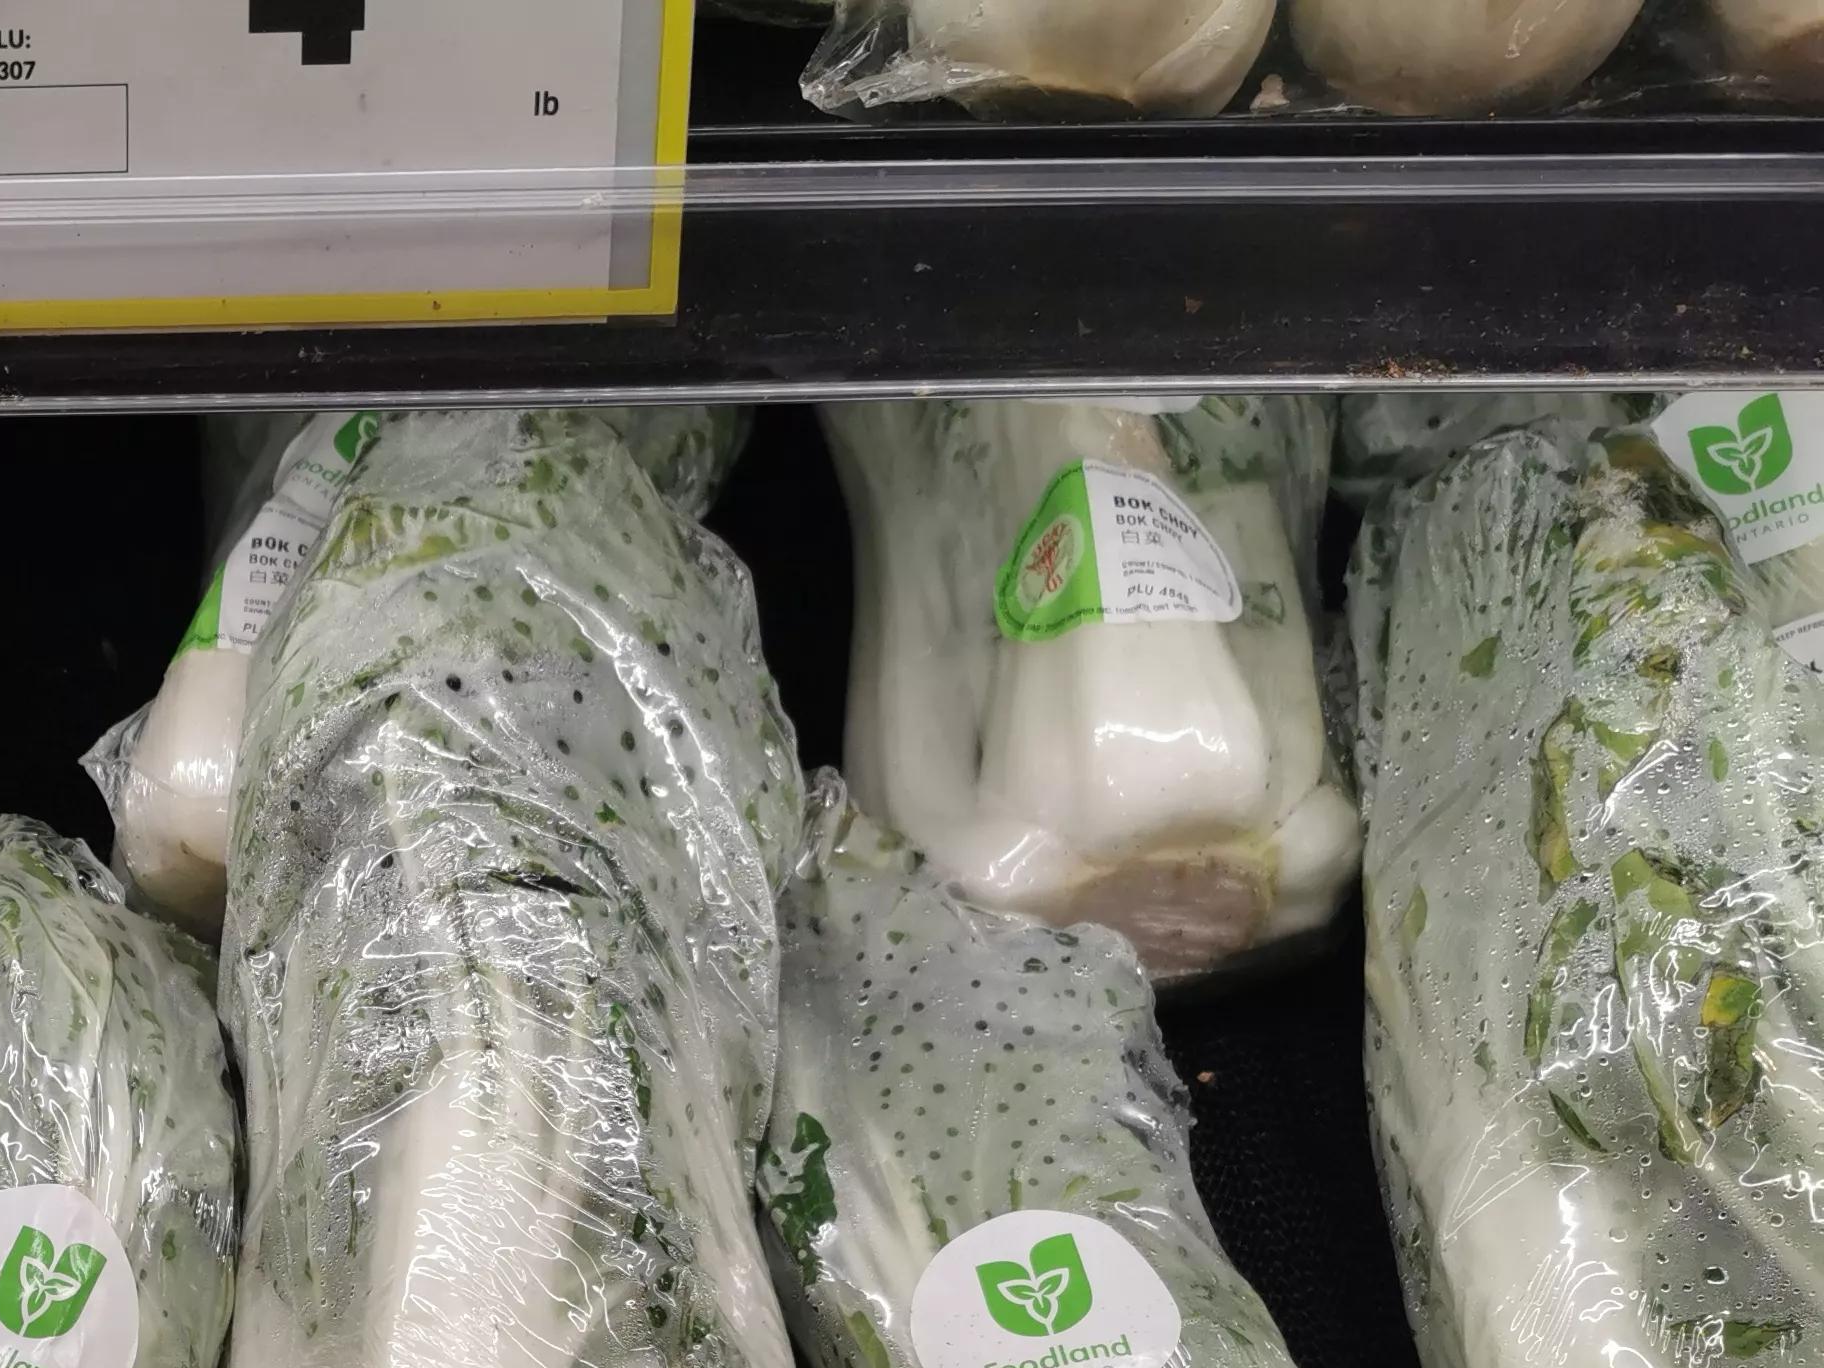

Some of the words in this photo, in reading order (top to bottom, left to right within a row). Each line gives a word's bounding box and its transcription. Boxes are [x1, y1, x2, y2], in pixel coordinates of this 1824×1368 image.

[534, 91, 560, 117] lb
[1113, 496, 1154, 512] BOK
[1158, 507, 1198, 540] CHOY
[1116, 514, 1147, 527] BOK
[1736, 513, 1810, 544] NTARIO
[251, 537, 289, 553] BOK
[249, 553, 278, 567] BOK
[1127, 584, 1154, 598] PLU
